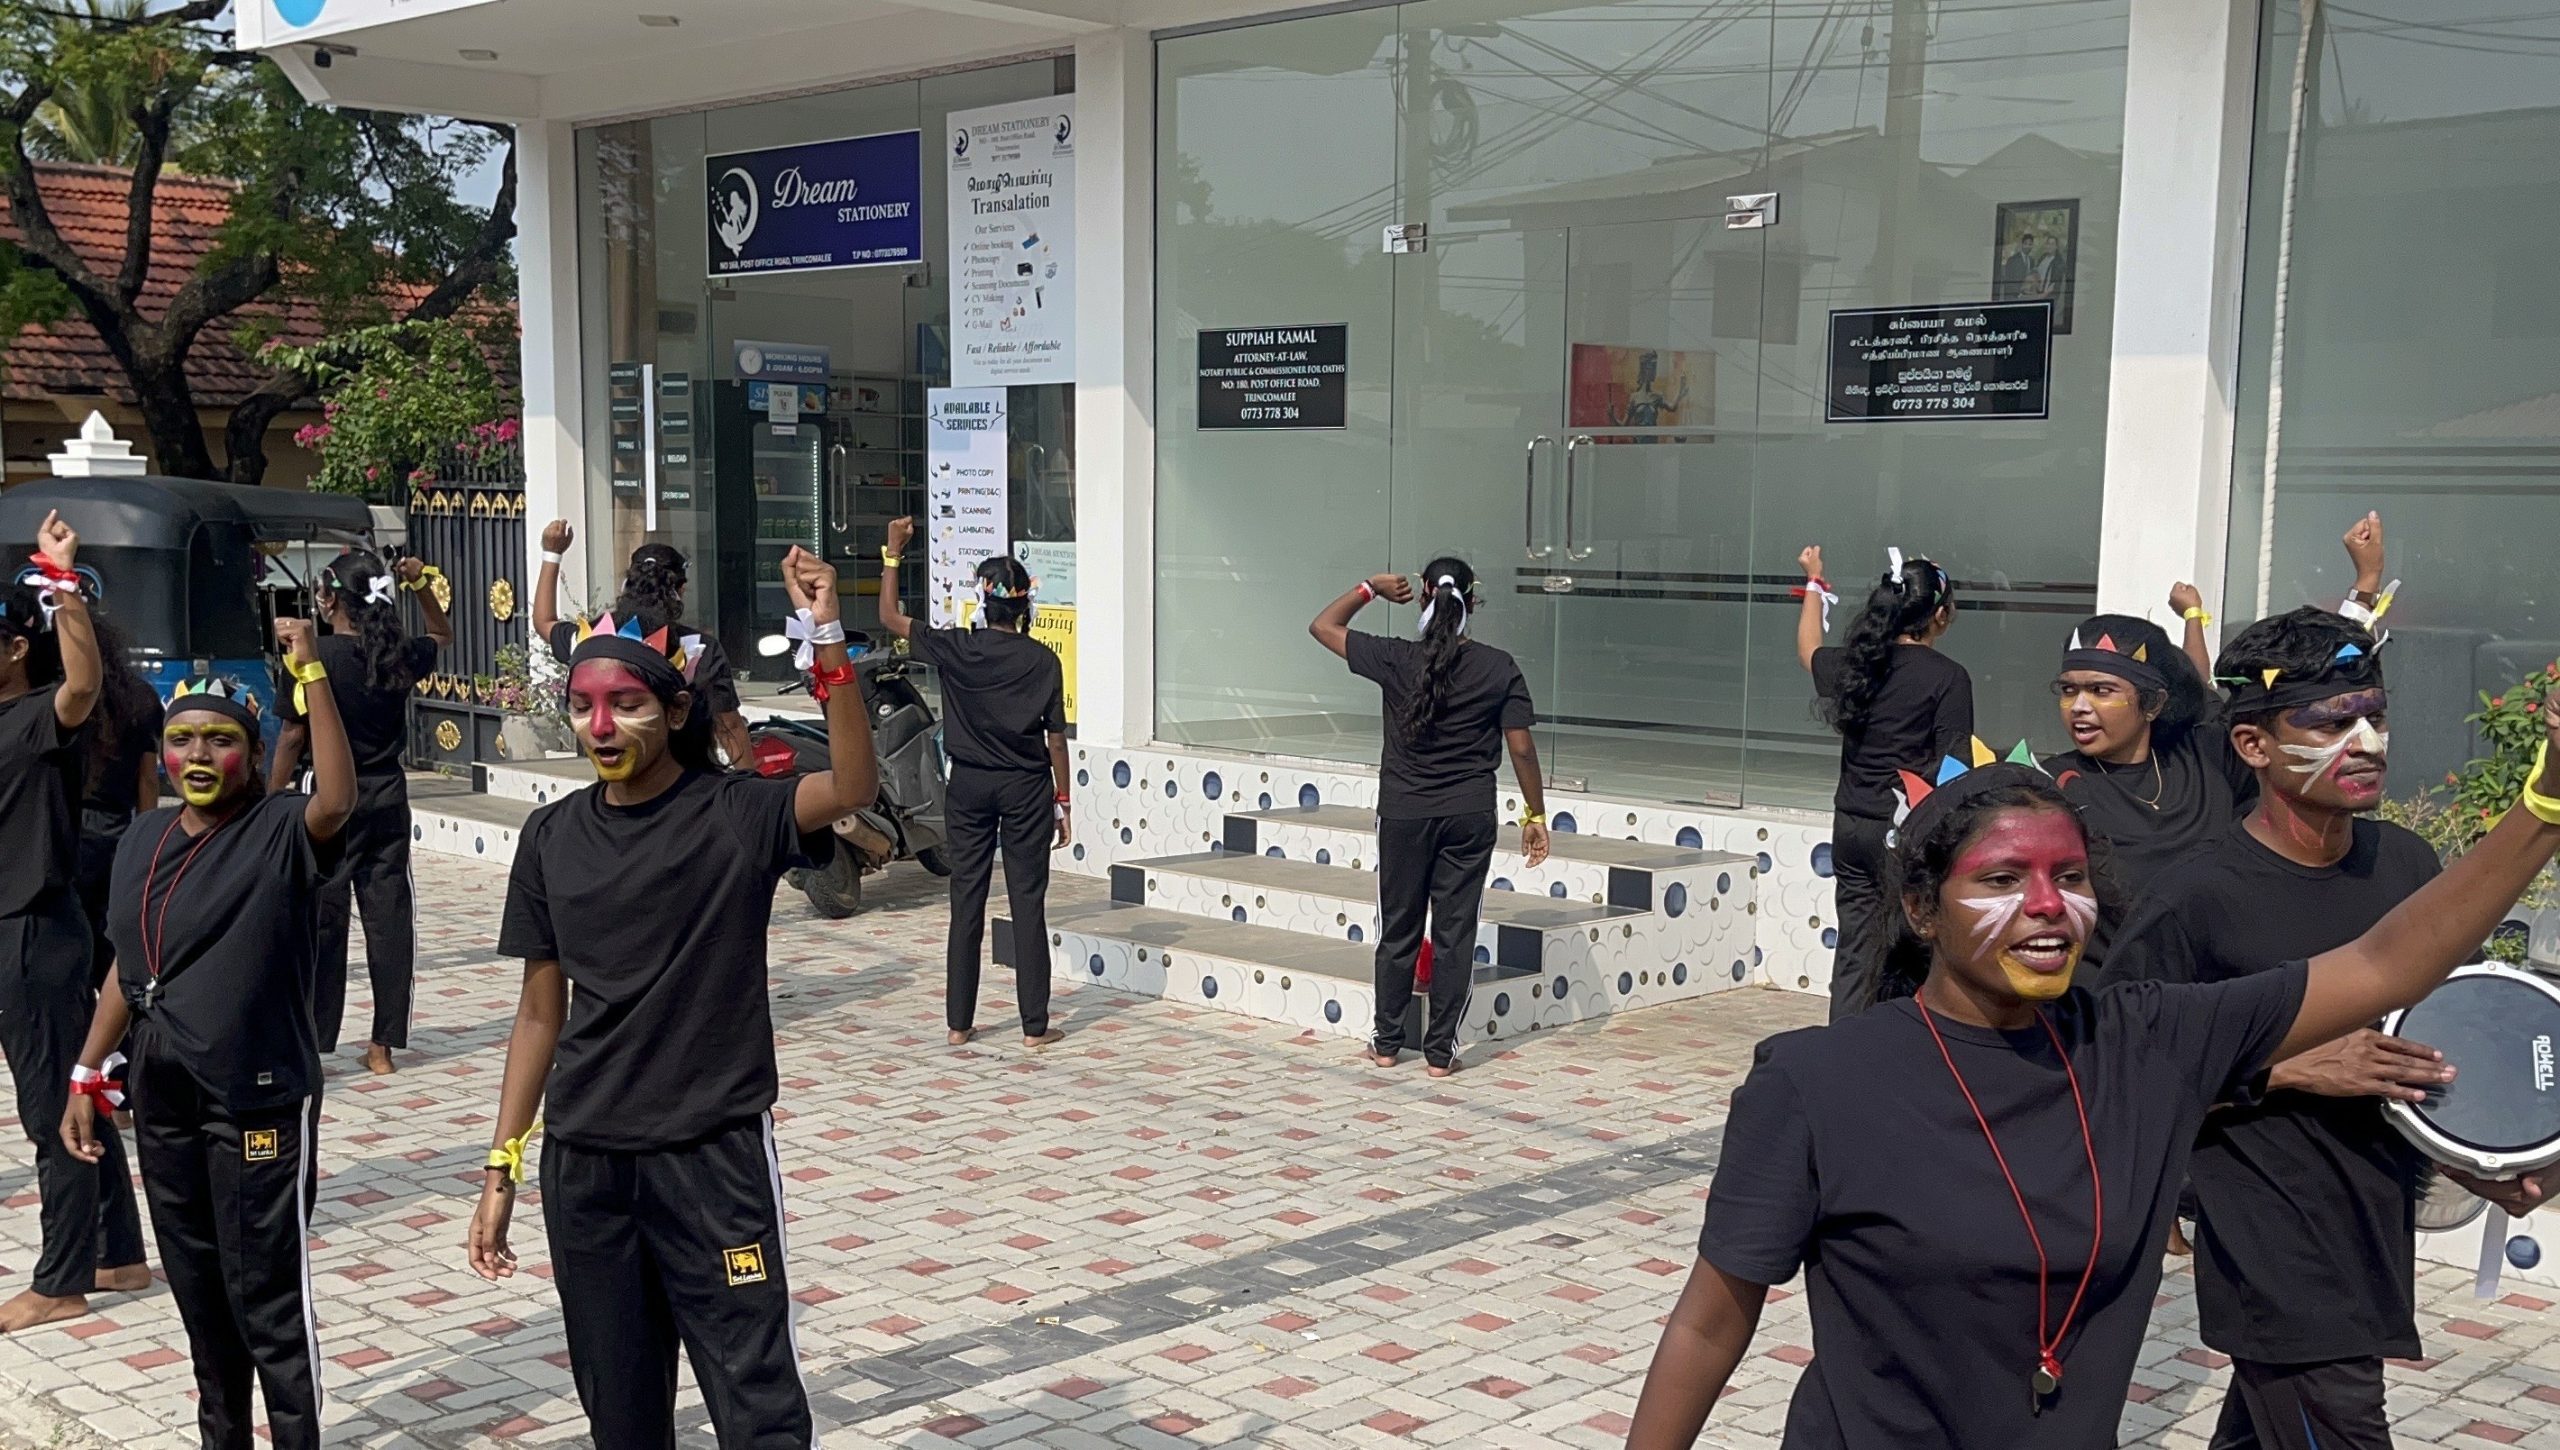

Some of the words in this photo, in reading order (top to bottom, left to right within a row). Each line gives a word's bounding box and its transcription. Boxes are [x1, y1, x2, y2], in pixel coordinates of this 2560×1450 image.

[972, 122, 1000, 137] DREAM
[1001, 116, 1050, 132] STATIONERY
[772, 166, 858, 208] Dream
[967, 169, 1053, 194] மொழிபெயர்ப்பு
[971, 192, 1050, 215] Transalation
[838, 202, 910, 223] STATIONERY
[974, 225, 987, 235] Our
[989, 224, 1015, 234] Services
[971, 243, 990, 251] Online
[991, 241, 1014, 250] booking
[719, 261, 729, 270] NO
[740, 259, 754, 268] POST
[755, 258, 774, 267] OFFICE
[792, 253, 832, 264] TRINCOMALEE
[971, 256, 1000, 265] Photocopy
[971, 269, 994, 278] Printing
[971, 281, 998, 291] Scanning
[998, 279, 1030, 289] Documents
[971, 295, 981, 303] CV
[983, 294, 1004, 303] Making
[972, 308, 984, 316] PDF
[972, 320, 993, 329] G-Mail
[1888, 317, 1945, 331] சுப்பையா
[1953, 313, 1987, 327] கமல்
[1226, 331, 1274, 346] SUPPIAH
[1278, 329, 1317, 344] KAMAL
[966, 343, 982, 355] Fast
[988, 341, 1017, 353] Reliable
[1023, 340, 1062, 355] Affordable
[765, 353, 798, 362] WORKING
[799, 356, 822, 364] HOURS
[1200, 368, 1225, 377] NOTARY
[1225, 367, 1248, 377] PUBLIC
[1249, 367, 1254, 376] &
[1255, 365, 1306, 376] COMMISSIONER
[1308, 365, 1321, 374] FOR
[1322, 364, 1345, 373] OATHS
[1250, 379, 1269, 389] POST
[1269, 378, 1296, 389] OFFICE
[773, 390, 793, 398] PLEASE
[1244, 392, 1297, 403] TRINCOMALEE
[944, 402, 991, 415] AVAILABLE
[1892, 397, 1923, 411] 0773
[1925, 397, 1949, 410] 778
[1952, 397, 1976, 410] 304
[1241, 408, 1263, 420] 0773
[1265, 407, 1281, 420] 778
[1283, 406, 1299, 419] 304
[946, 418, 988, 431] SERVICES
[617, 441, 635, 450] TYPING
[667, 454, 688, 463] RELOAD
[956, 468, 977, 477] PHOTO
[978, 469, 994, 477] COPY
[961, 506, 992, 516] SCANNING
[958, 526, 995, 535] LAMINATING
[958, 547, 994, 557] STATIONERY
[2533, 1035, 2555, 1092] ROWELL
